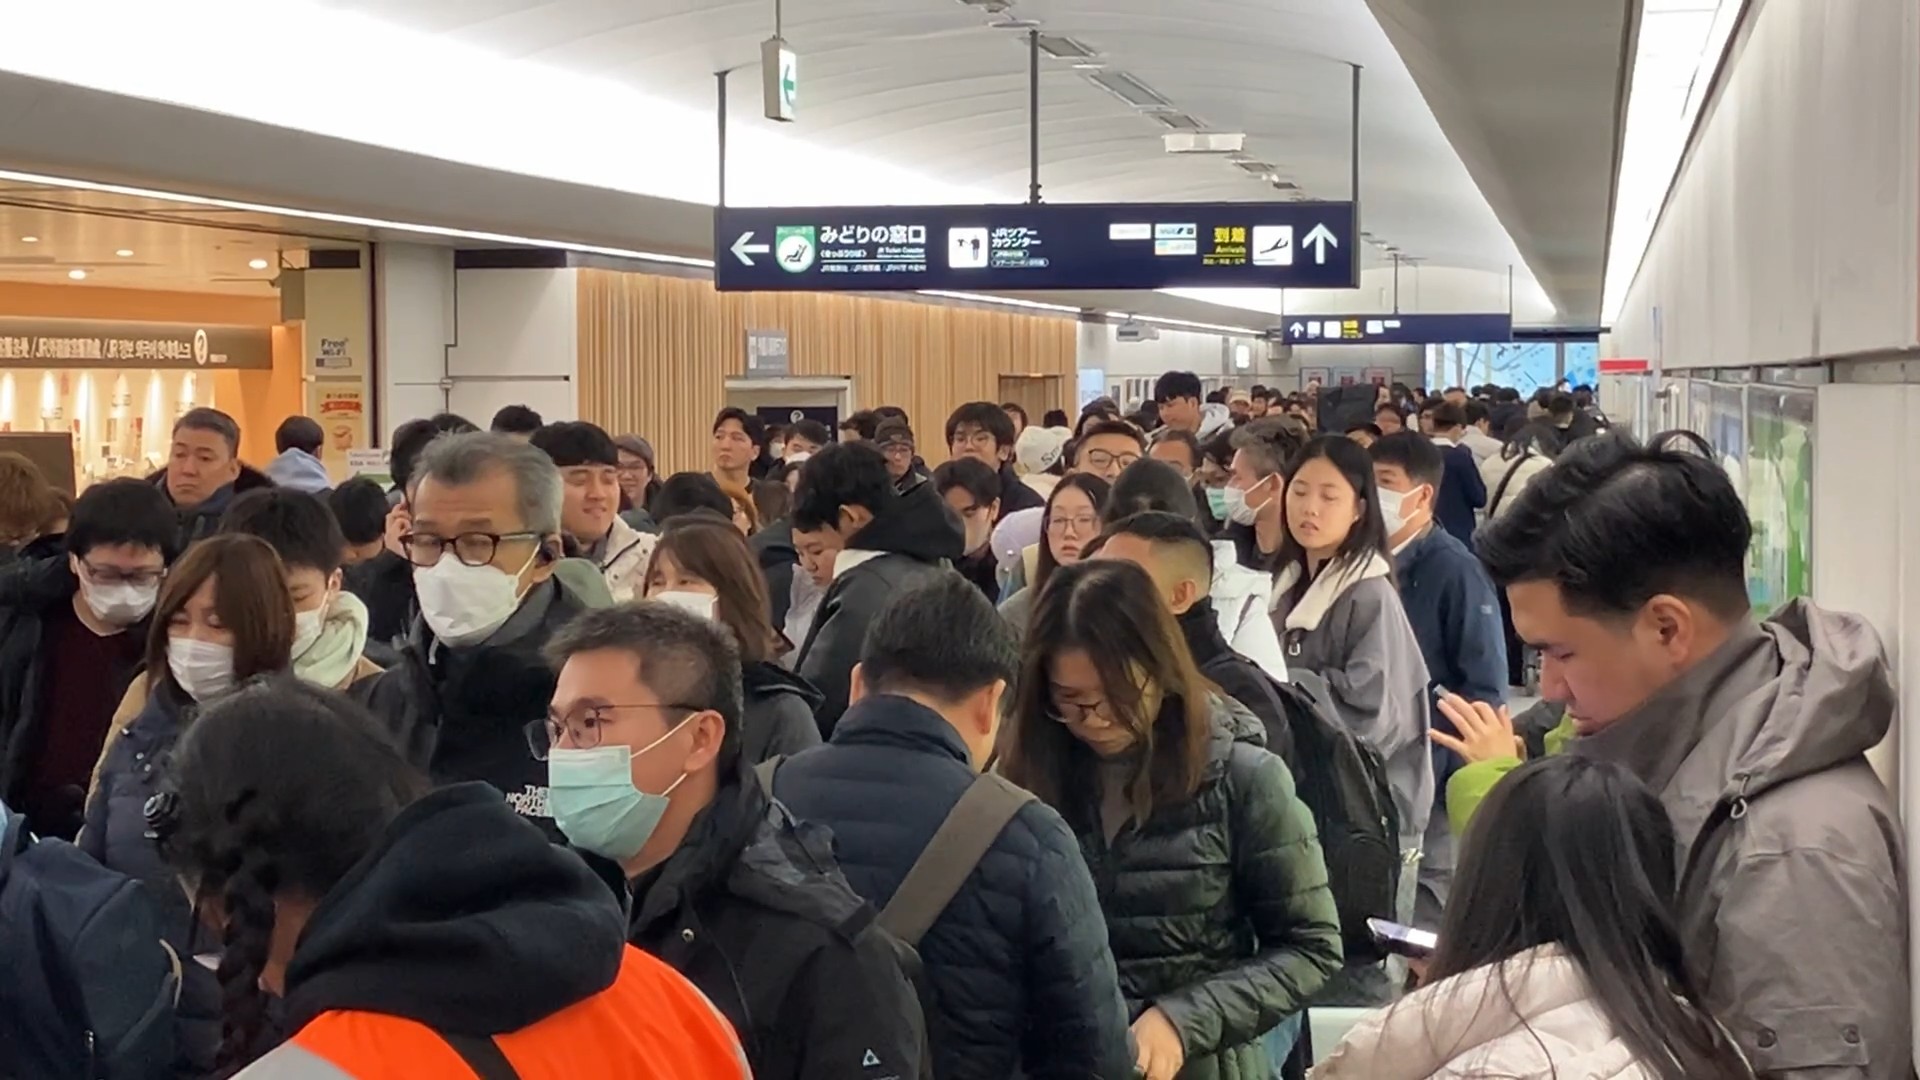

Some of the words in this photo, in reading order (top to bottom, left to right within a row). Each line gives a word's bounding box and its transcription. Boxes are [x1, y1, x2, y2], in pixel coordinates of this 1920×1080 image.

[820, 225, 926, 244] みどりの窓口
[991, 227, 1038, 238] JRツアー
[1213, 227, 1246, 243] 到着
[991, 237, 1042, 248] カウンター
[1215, 245, 1246, 254] Arrivals
[321, 338, 345, 348] Free
[525, 785, 547, 799] THE
[506, 793, 545, 808] NORTH
